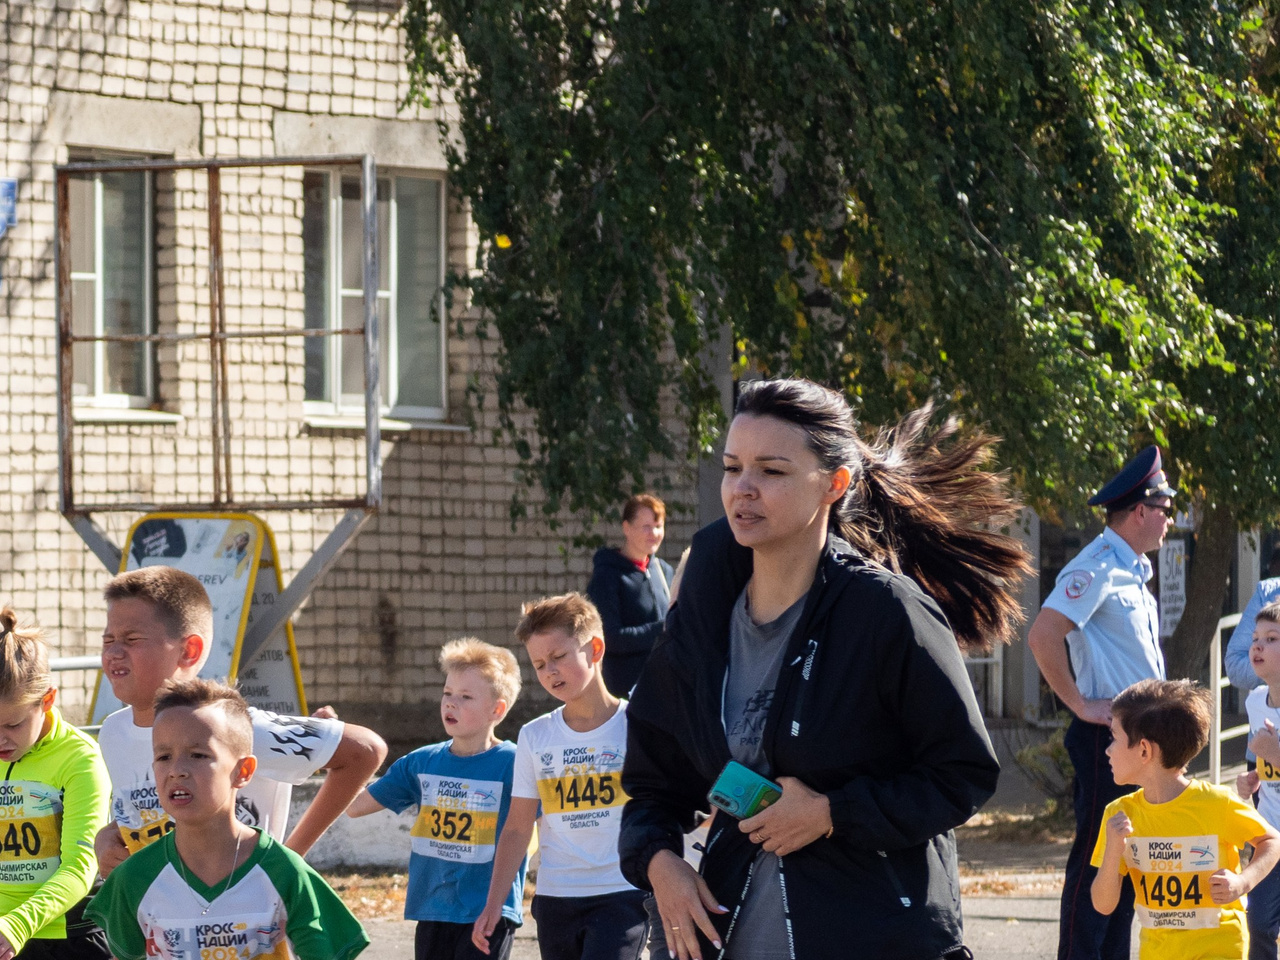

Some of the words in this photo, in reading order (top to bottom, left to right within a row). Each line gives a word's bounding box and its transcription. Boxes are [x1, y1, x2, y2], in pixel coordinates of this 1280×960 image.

[563, 747, 587, 757] КРОСС
[562, 755, 594, 765] НАЦИИ
[439, 780, 463, 790] КРОСС
[437, 789, 467, 798] НАЦИИ
[555, 776, 615, 809] 1445
[132, 798, 162, 810] НАЦИ
[562, 810, 610, 822] ВЛАДИМИРСКАЯ
[431, 809, 473, 841] 352
[570, 821, 599, 829] ОБЛАСТЬ
[429, 840, 472, 853] ВЛАДИМИРСКАЯ
[1149, 842, 1173, 850] КРОСС
[437, 849, 461, 859] ОБЛАСТЬ
[1149, 852, 1181, 860] НАЦИИ
[0, 872, 35, 881] ОБЛАСТЬ
[1140, 874, 1203, 907] 1494
[195, 922, 234, 937] КРОСС
[197, 934, 247, 948] НАЦИИ
